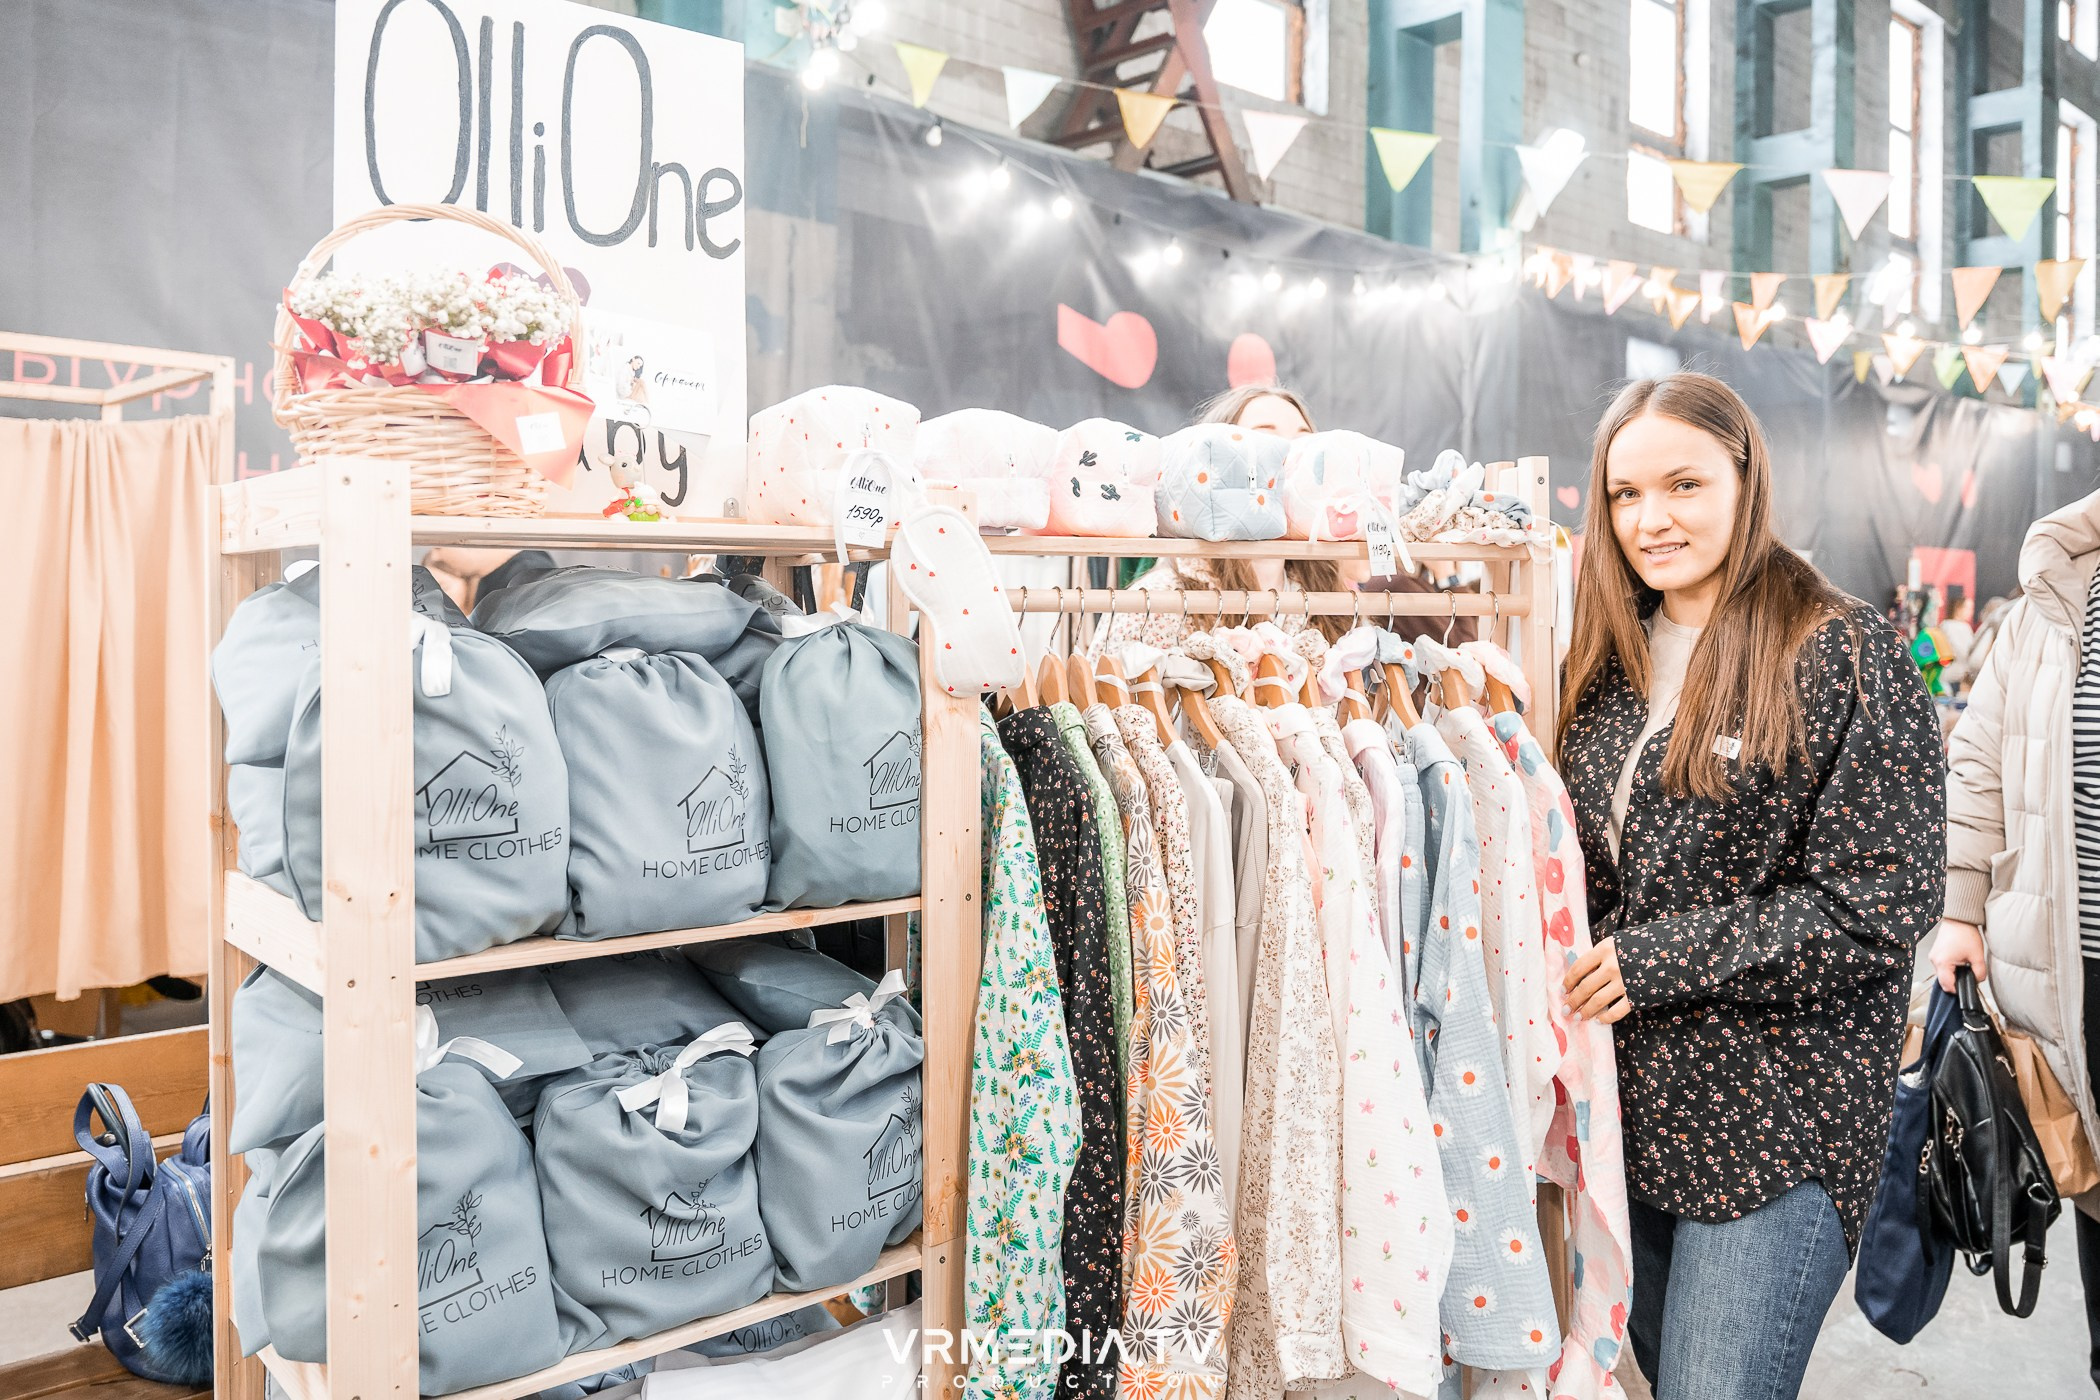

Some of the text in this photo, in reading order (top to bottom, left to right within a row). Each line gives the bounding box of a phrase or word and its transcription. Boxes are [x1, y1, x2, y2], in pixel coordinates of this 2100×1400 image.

[364, 0, 743, 259] OlliOne
[428, 783, 519, 827] OlliOne
[686, 795, 746, 838] OlliOne
[829, 812, 887, 834] HOME
[416, 827, 562, 861] ME CLOTHES
[642, 840, 770, 878] HOME CLOTHES
[867, 1136, 918, 1185] OlliOne
[831, 1179, 921, 1232] HOME CLOT
[651, 1208, 726, 1248] OlliOne
[601, 1233, 763, 1288] HOME CLOTHES
[443, 1266, 537, 1323] CLOTHES
[743, 1320, 803, 1353] OlliOne
